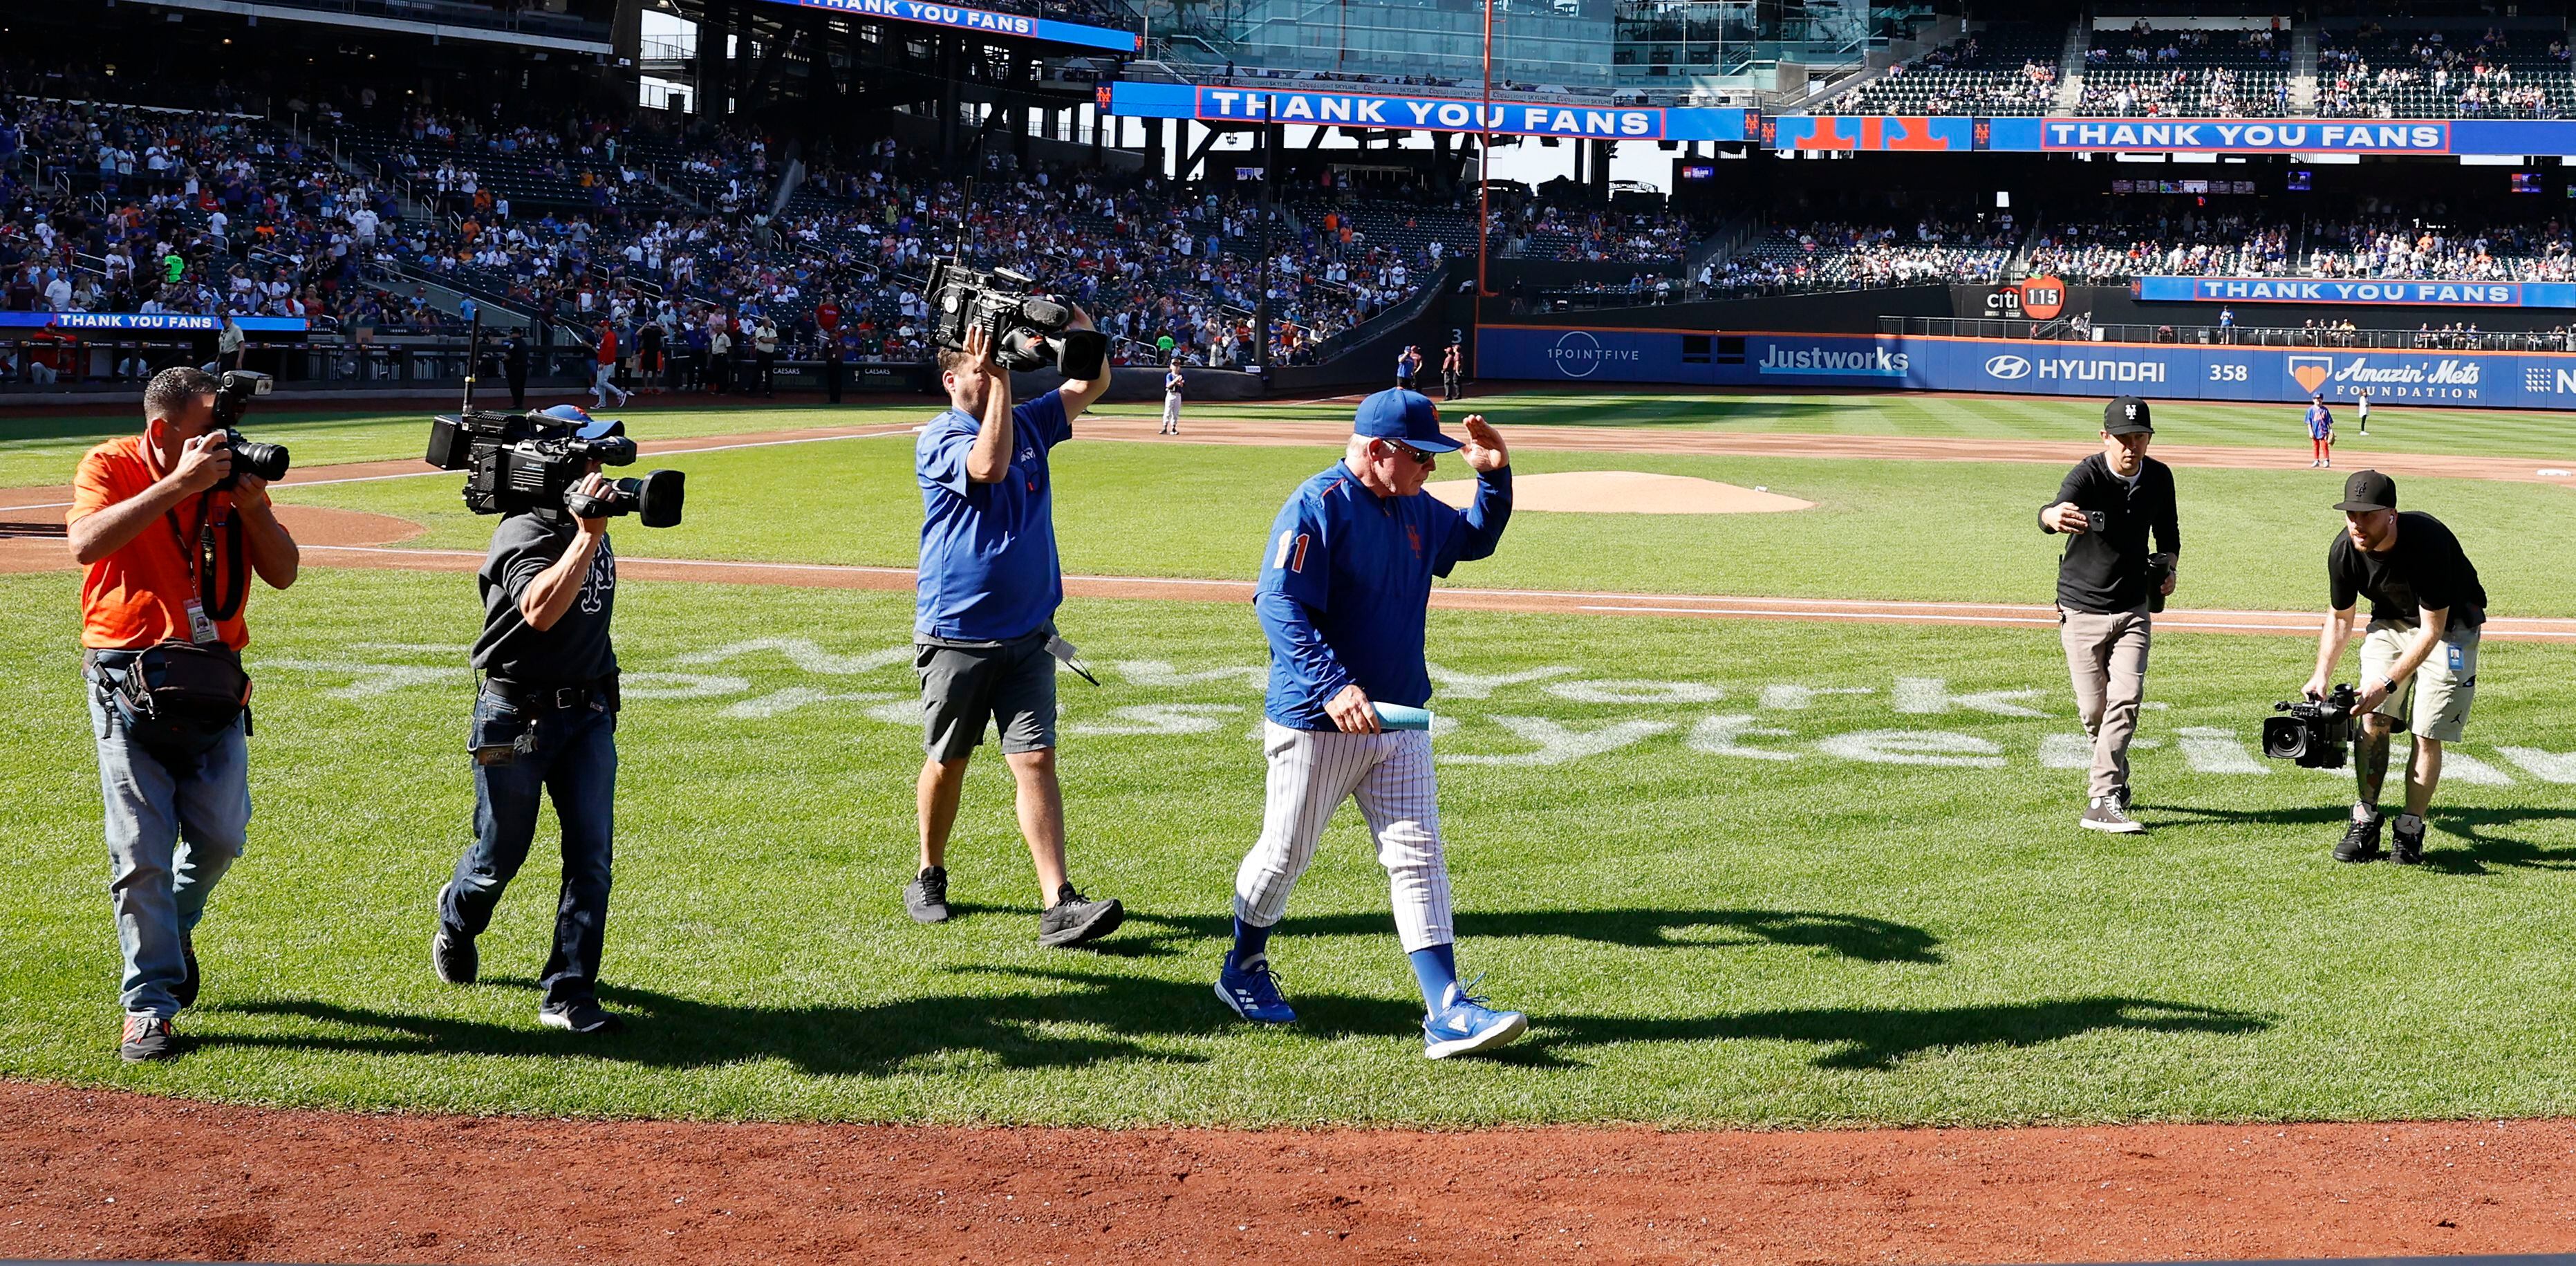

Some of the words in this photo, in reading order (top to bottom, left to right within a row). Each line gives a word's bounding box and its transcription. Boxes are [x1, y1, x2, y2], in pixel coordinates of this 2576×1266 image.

[814, 0, 899, 15] ANK
[909, 4, 958, 23] YOU
[967, 12, 1029, 33] FANS
[1212, 92, 1386, 122] THANK
[1406, 101, 1504, 128] YOU
[1524, 108, 1649, 135] FANS
[2051, 124, 2201, 146] THANK
[2216, 125, 2306, 147] YOU
[2322, 126, 2439, 147] FANS
[1987, 290, 2019, 308] citi
[2029, 289, 2057, 304] 115
[2205, 281, 2321, 299] THANK
[2335, 284, 2405, 301] YOU
[2418, 286, 2510, 302] FANS
[61, 315, 122, 326] THANK
[129, 316, 163, 327] YOU
[169, 317, 212, 328] FANS
[1451, 328, 1462, 344] 3
[1547, 349, 1639, 361] 1POINTFIVE
[1759, 344, 1909, 371] Justworks
[2039, 359, 2165, 382] HYUNDAI
[2209, 364, 2248, 381] 358
[2335, 357, 2428, 383] Amazin'
[2429, 360, 2480, 384] Mets
[2337, 385, 2478, 398] FOUNDATION
[1273, 529, 1310, 574] 11
